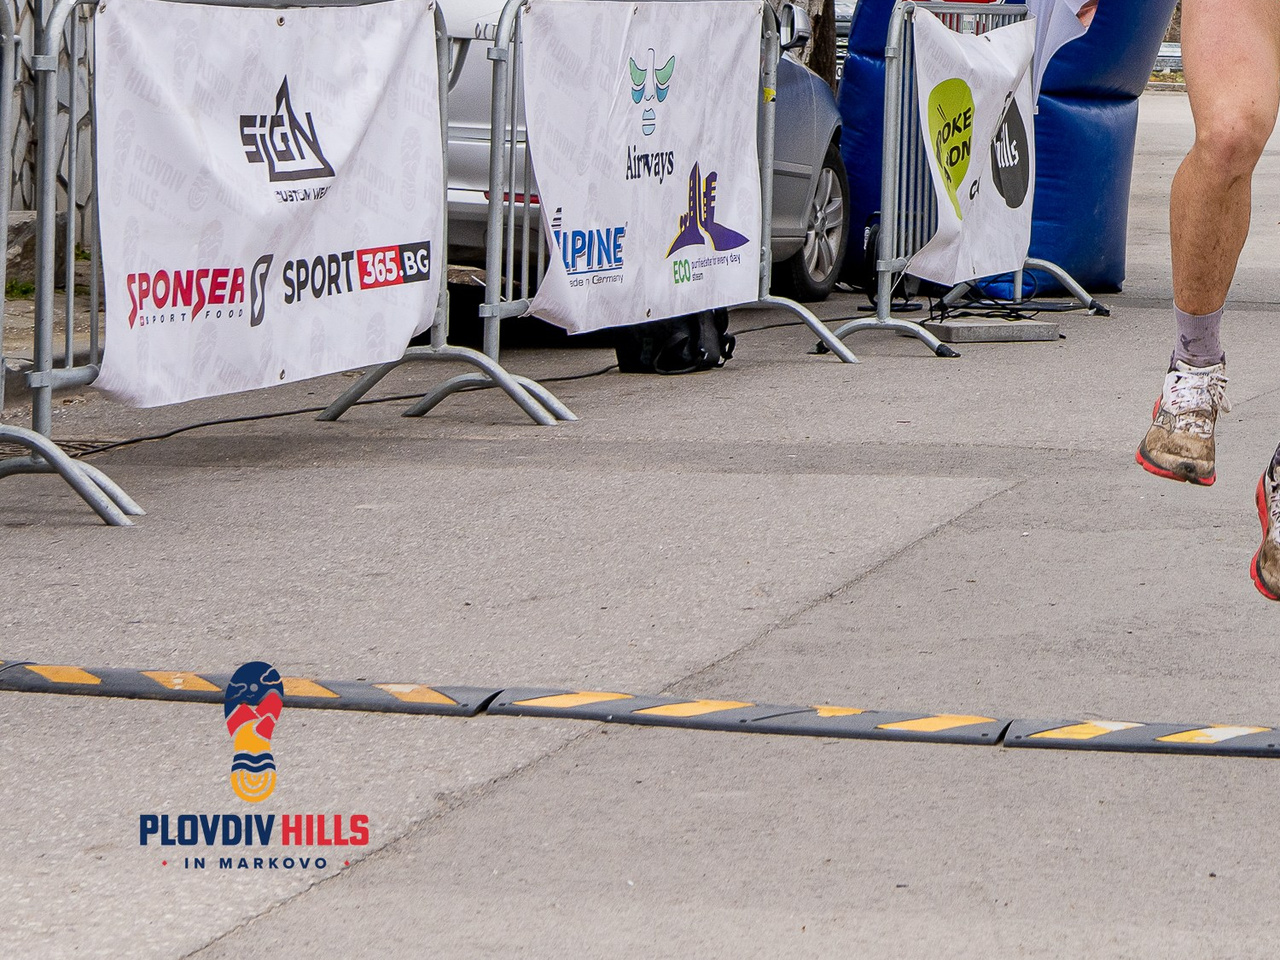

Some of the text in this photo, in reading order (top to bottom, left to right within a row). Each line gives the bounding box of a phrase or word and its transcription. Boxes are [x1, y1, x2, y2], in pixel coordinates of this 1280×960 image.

[625, 144, 674, 185] Airways
[283, 251, 354, 305] SPORT
[672, 259, 691, 285] ECO
[145, 308, 244, 326] SPORT FOOD
